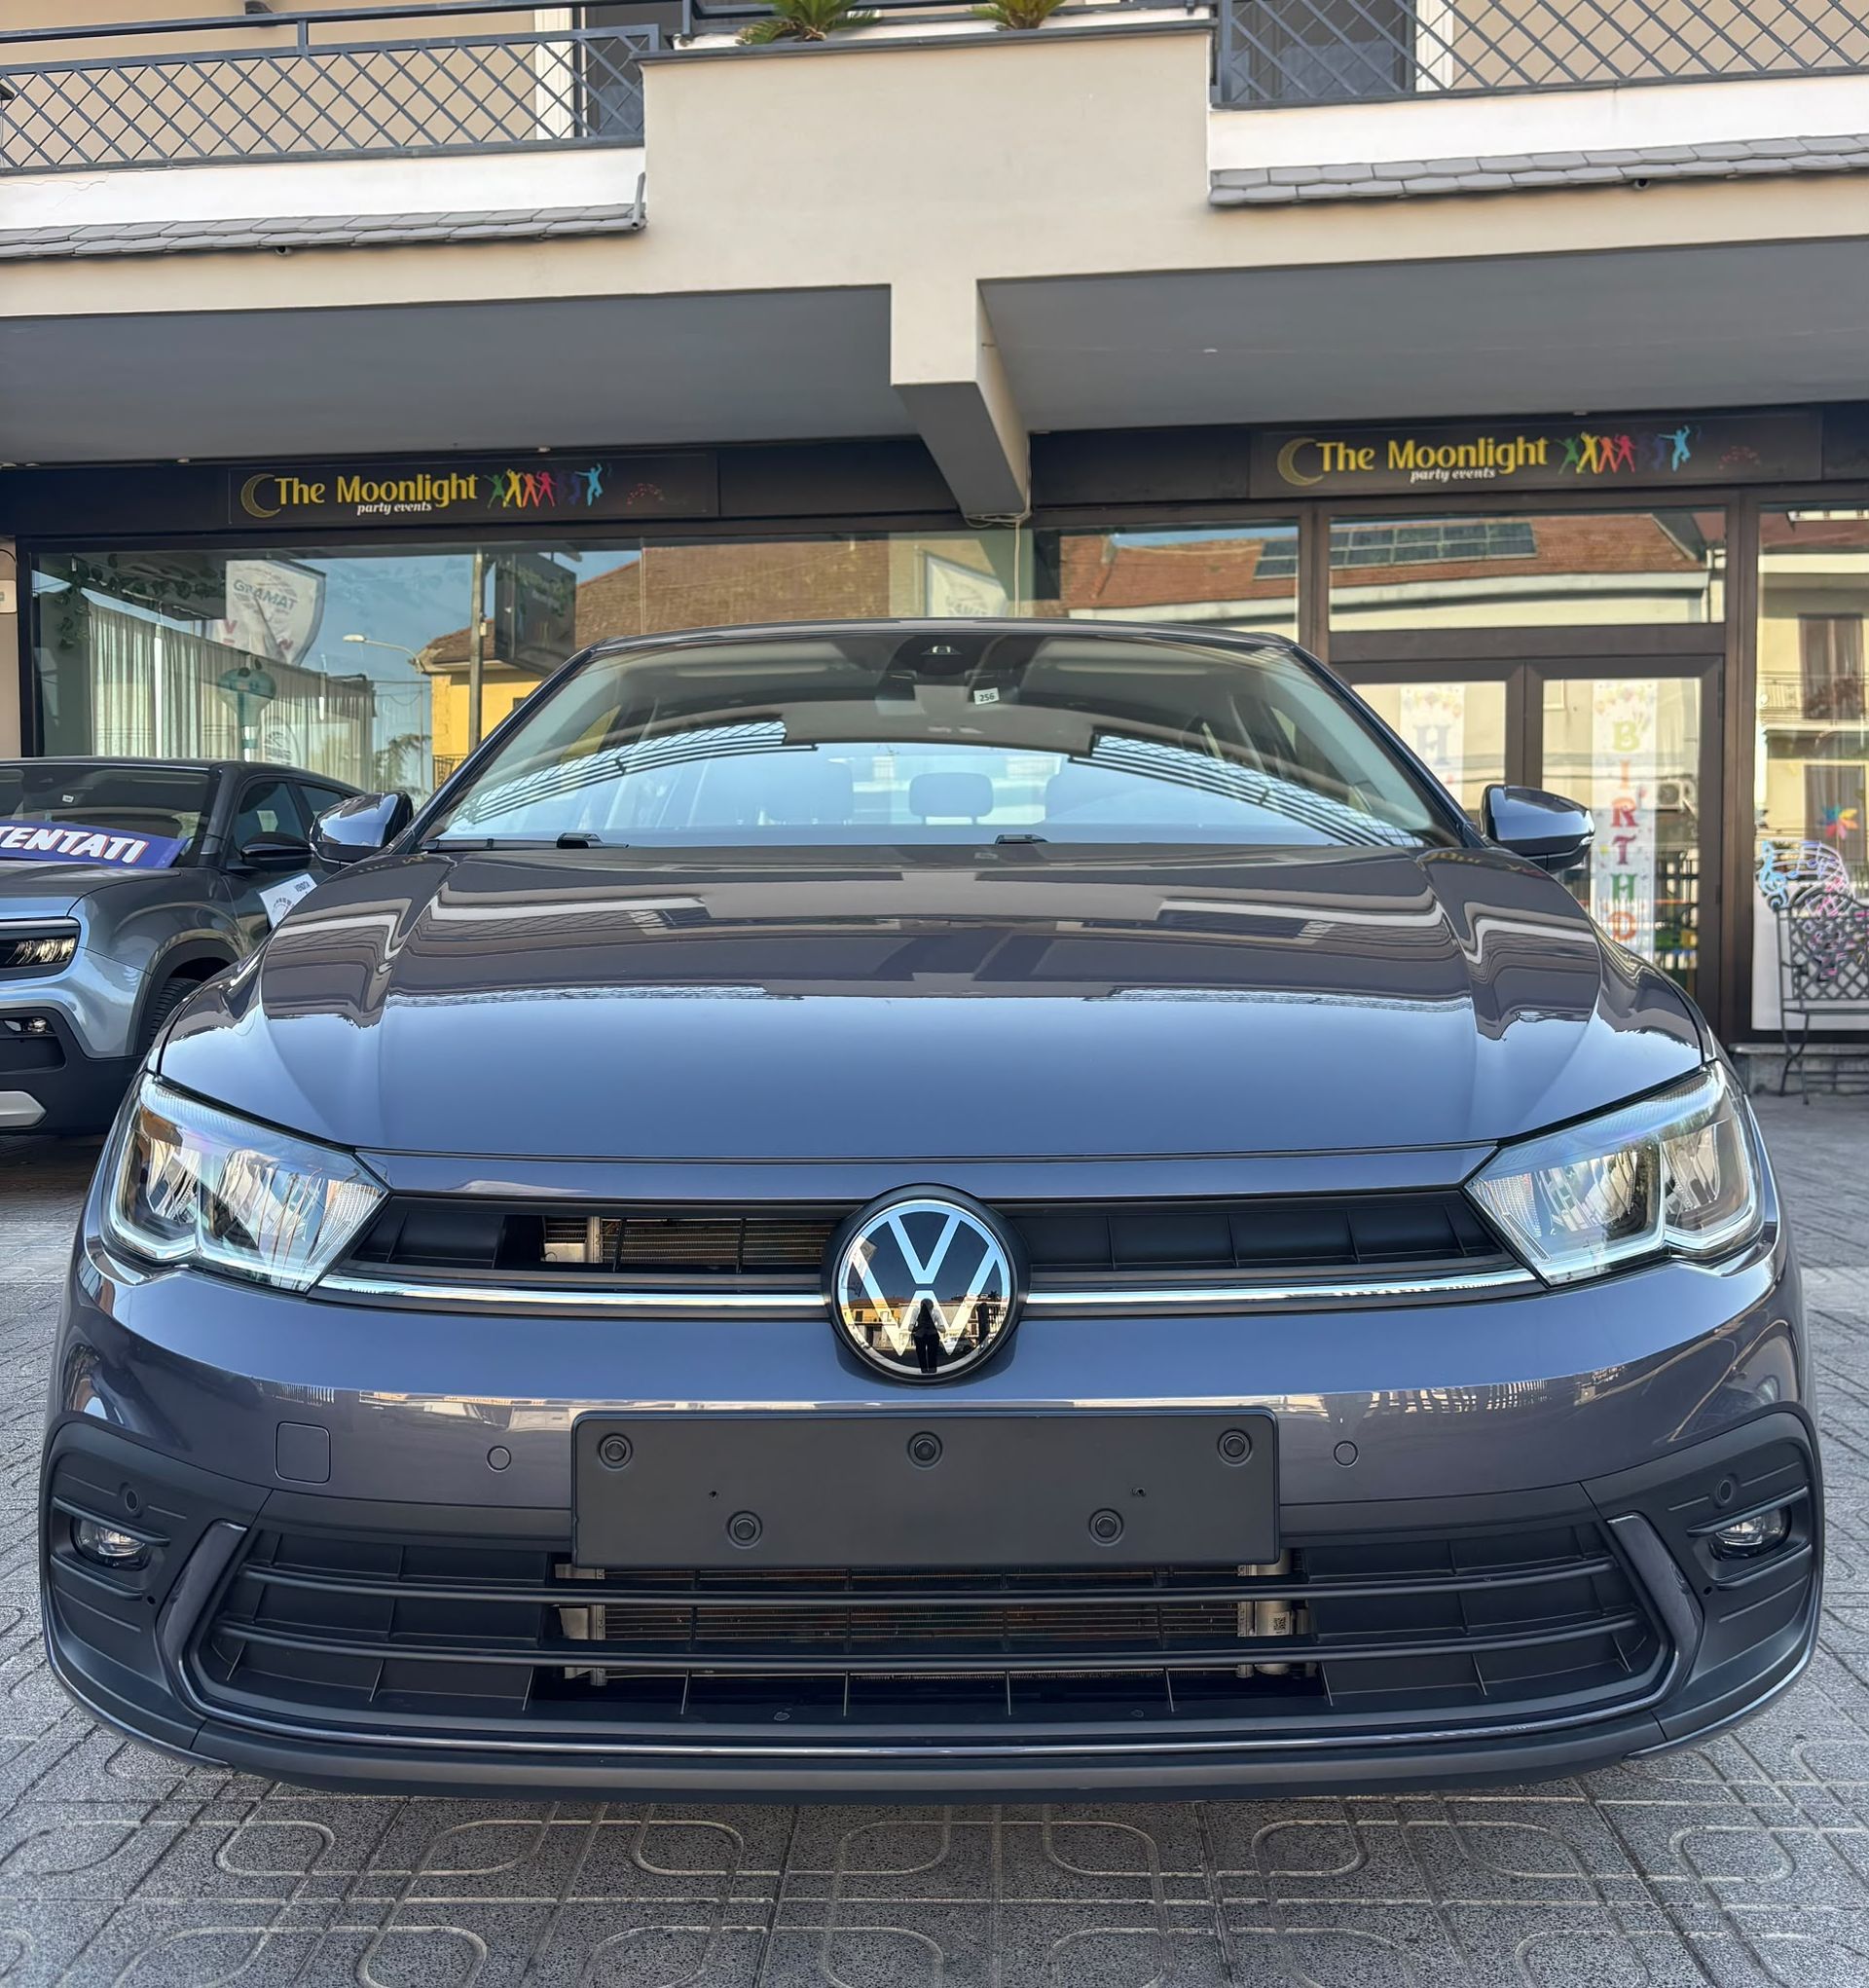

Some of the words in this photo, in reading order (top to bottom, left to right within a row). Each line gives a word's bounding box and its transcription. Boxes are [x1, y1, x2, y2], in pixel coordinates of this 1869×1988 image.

[1316, 440, 1375, 472] The
[1388, 436, 1550, 474] Moonlight
[1411, 469, 1449, 484] party
[1451, 468, 1496, 480] events
[274, 477, 326, 505] The
[337, 472, 479, 508] Moonlight
[356, 501, 391, 516] party
[393, 500, 432, 513] events
[978, 692, 995, 702] 256
